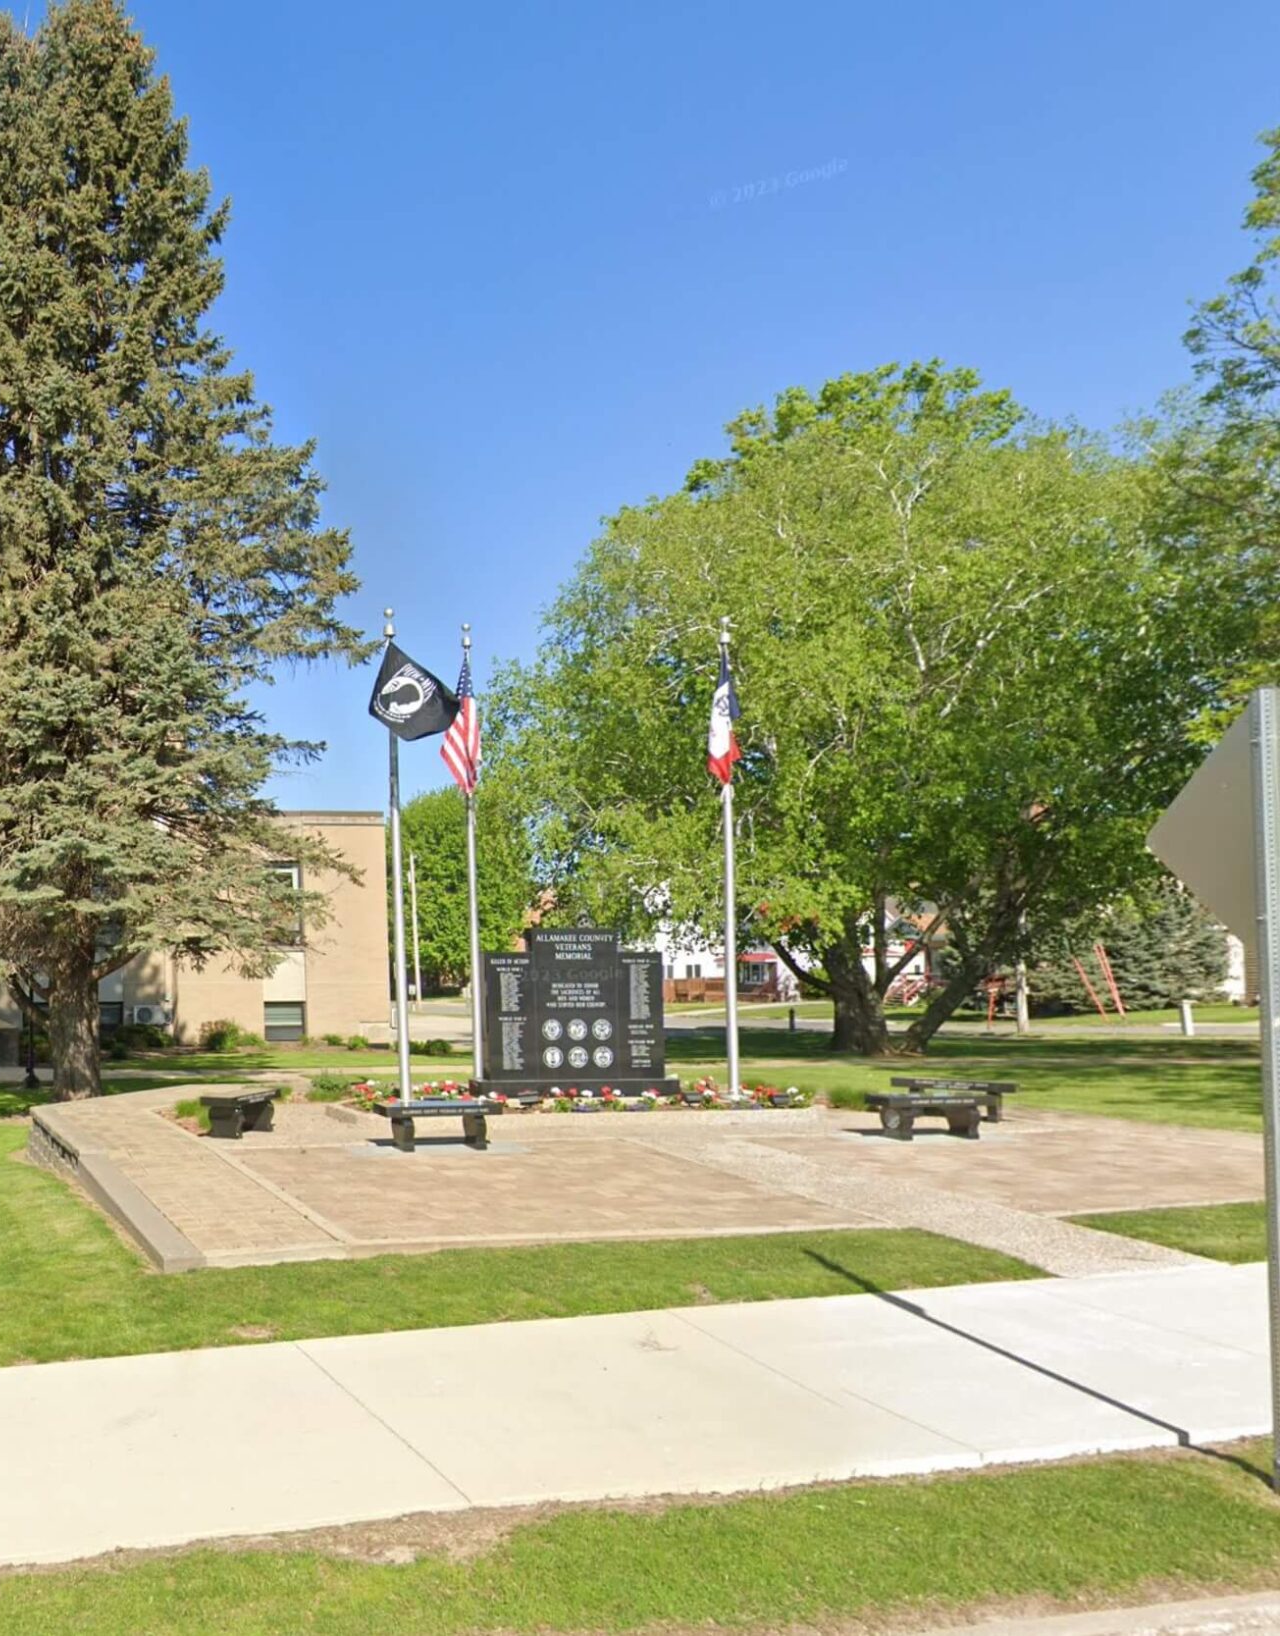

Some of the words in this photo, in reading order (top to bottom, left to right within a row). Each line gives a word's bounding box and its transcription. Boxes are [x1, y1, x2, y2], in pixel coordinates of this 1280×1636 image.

[536, 934, 577, 942] ALLAMAKEE
[579, 934, 614, 942] COUNTY
[554, 943, 592, 951] VETERANS
[554, 952, 593, 960] MEMORIAL
